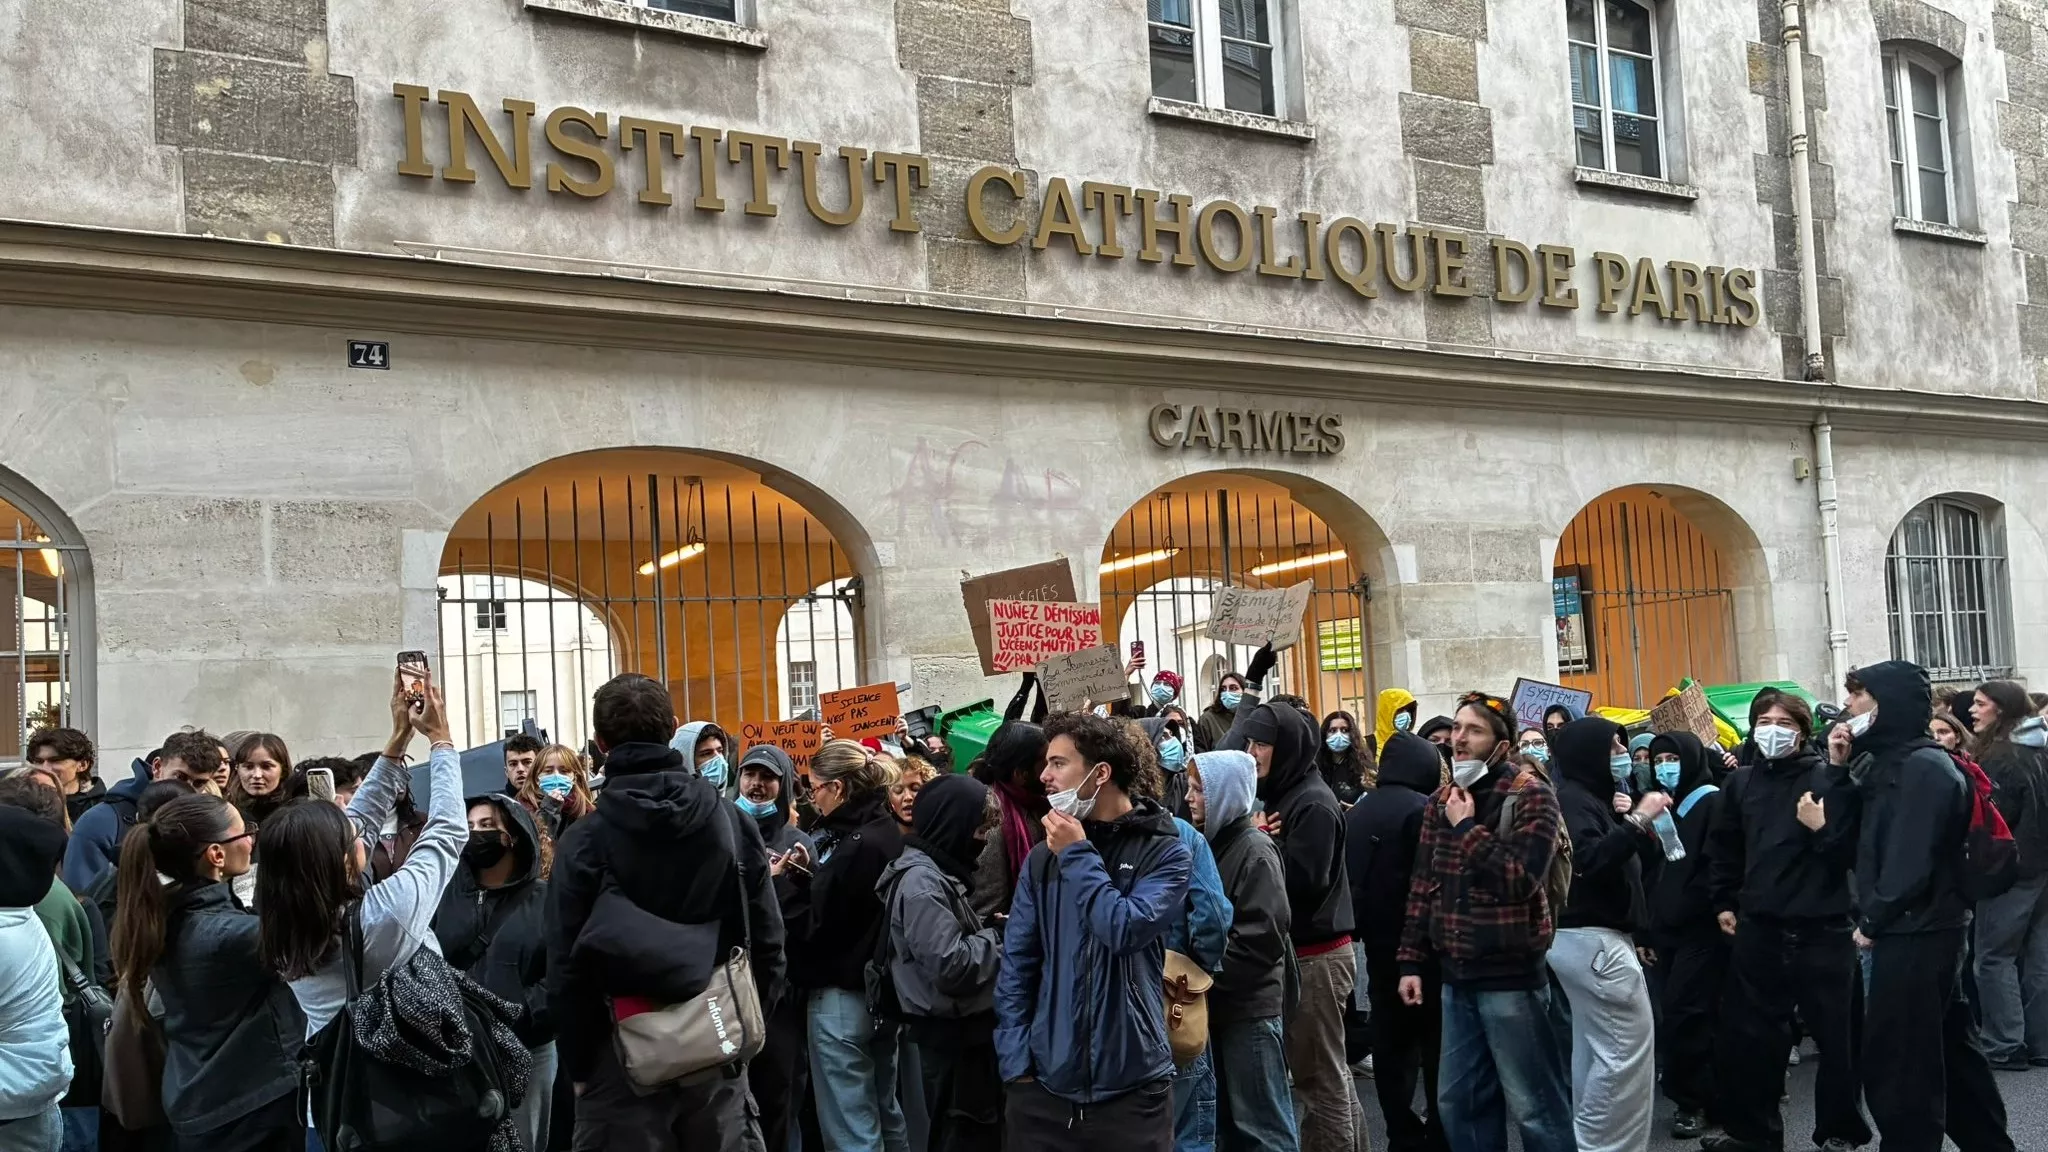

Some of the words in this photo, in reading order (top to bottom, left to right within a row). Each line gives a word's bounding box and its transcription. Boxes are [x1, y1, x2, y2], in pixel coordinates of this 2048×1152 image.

[393, 82, 930, 233] INSTITUT
[967, 165, 1474, 299] CATHOLIQUE
[1490, 237, 1579, 309] DE
[1594, 251, 1760, 328] PARIS
[354, 344, 384, 365] 74
[1149, 402, 1346, 454] CARMES
[993, 601, 1039, 620] NUÑEZ
[995, 620, 1045, 639] JUSTICE
[1045, 626, 1074, 641] POUR
[1076, 629, 1097, 642] LES
[999, 638, 1040, 652] LYCÉENS
[823, 692, 840, 705] LE
[840, 693, 882, 709] SILENCE
[850, 706, 868, 719] PAS
[743, 724, 763, 738] ON
[772, 723, 799, 736] VEUT
[802, 724, 818, 735] UN
[850, 714, 898, 733] INNOCENT
[782, 739, 797, 749] PAS
[803, 739, 817, 749] UN
